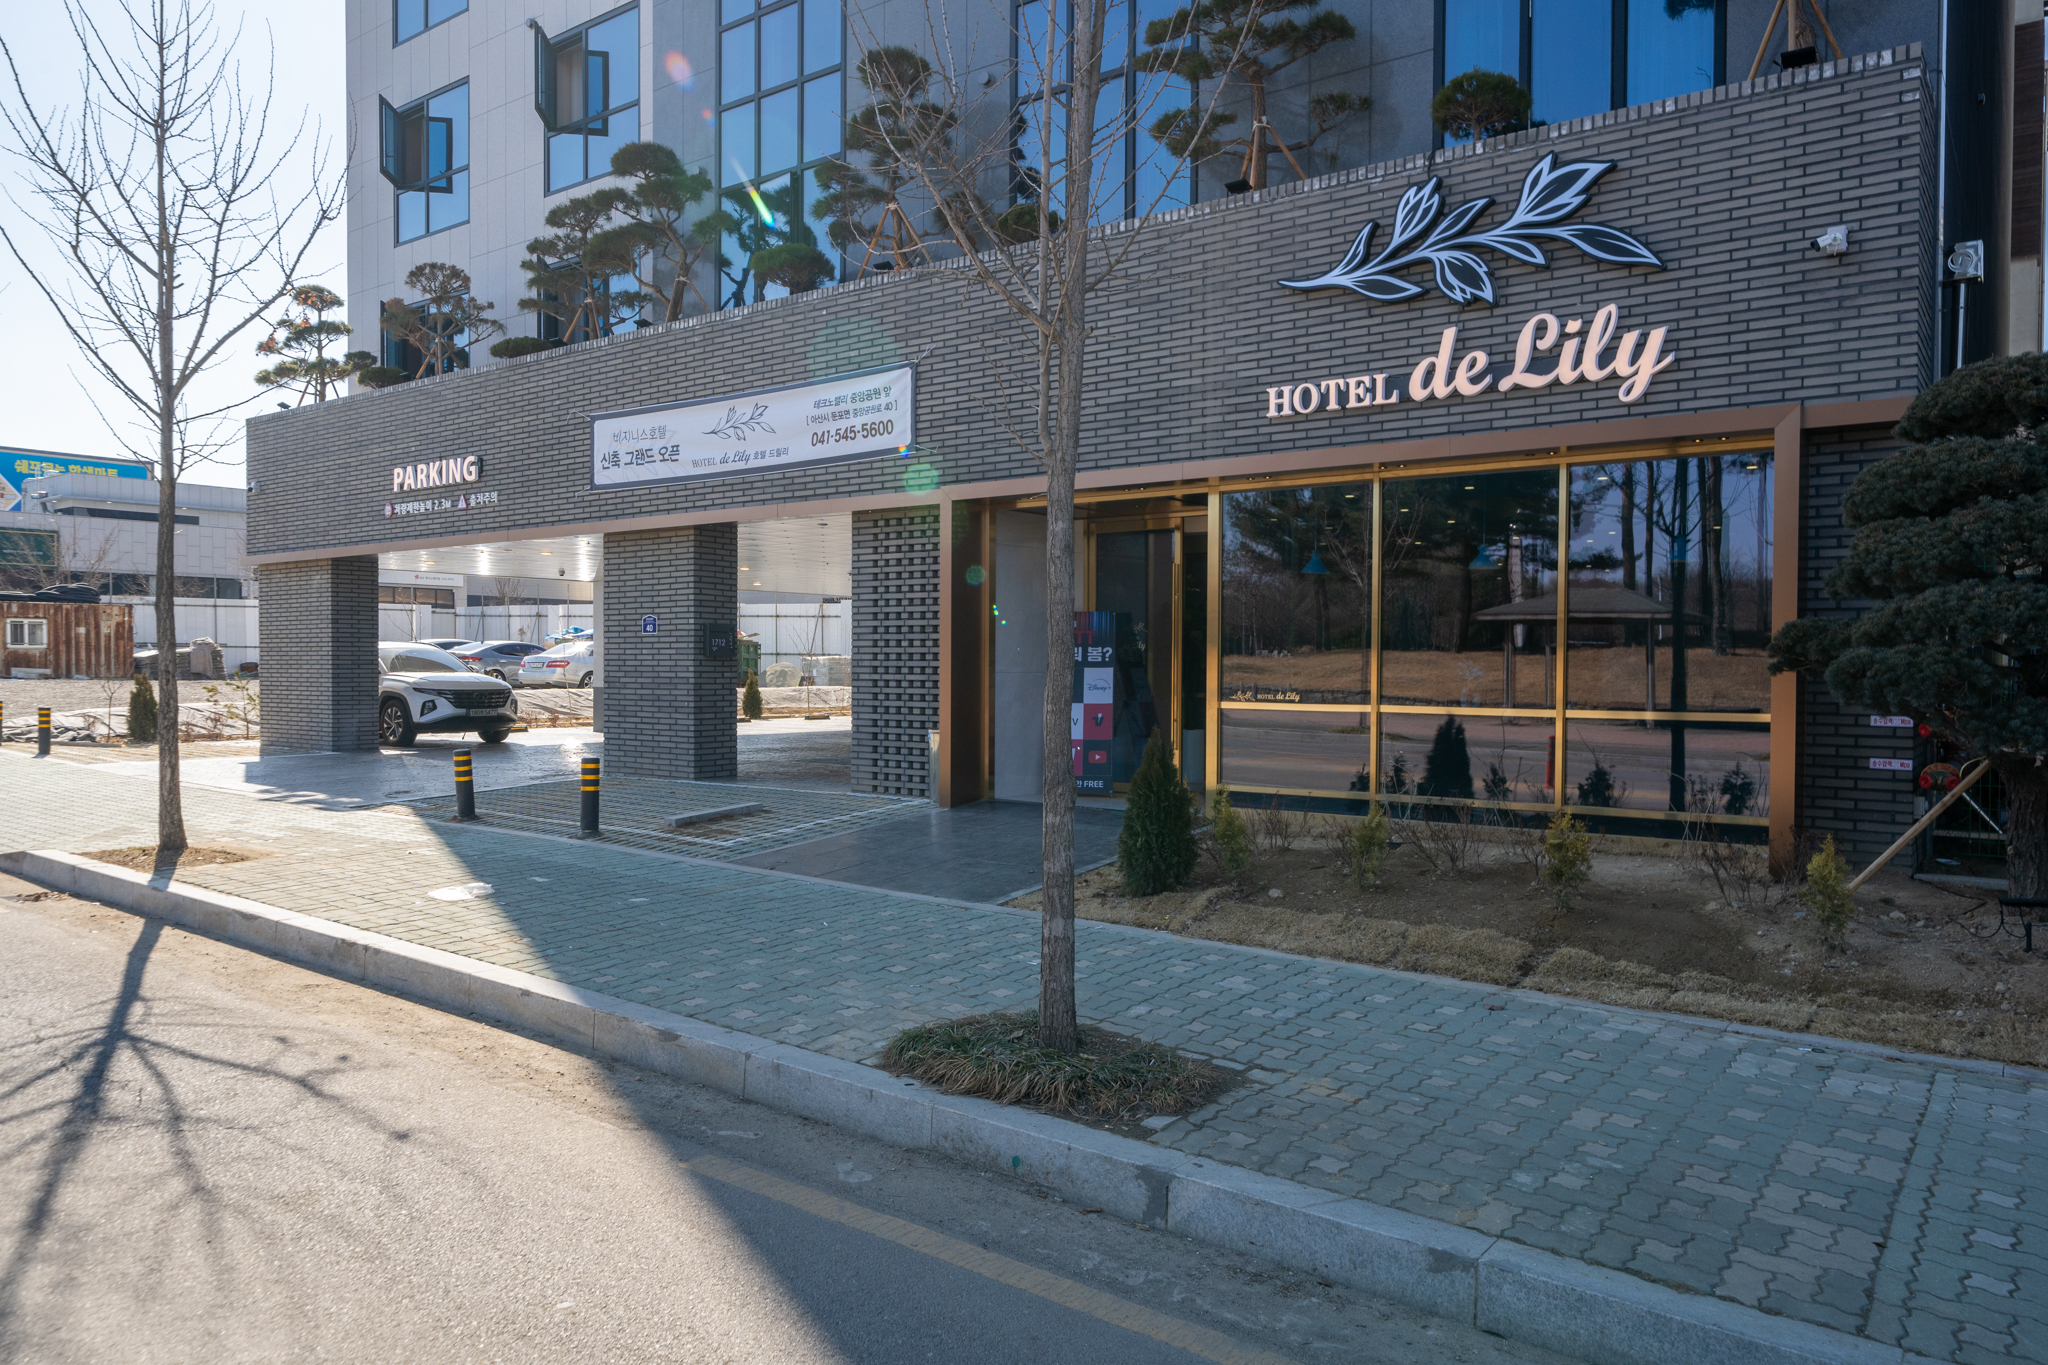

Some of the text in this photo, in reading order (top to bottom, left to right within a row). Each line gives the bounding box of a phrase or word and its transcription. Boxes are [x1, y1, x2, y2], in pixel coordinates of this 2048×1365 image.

[1265, 303, 1676, 418] HOTEL de Lily
[850, 387, 882, 404] 중앙공원
[810, 412, 830, 424] 아산시
[884, 401, 893, 411] 40
[600, 444, 681, 470] 신축 그랜드 오픈
[691, 457, 718, 469] HOTEL
[719, 453, 731, 465] de
[731, 449, 751, 466] Lily
[393, 455, 479, 492] PARKING
[1087, 646, 1113, 662] 봄?
[1285, 691, 1301, 703] Lily
[1083, 780, 1104, 788] FREE
